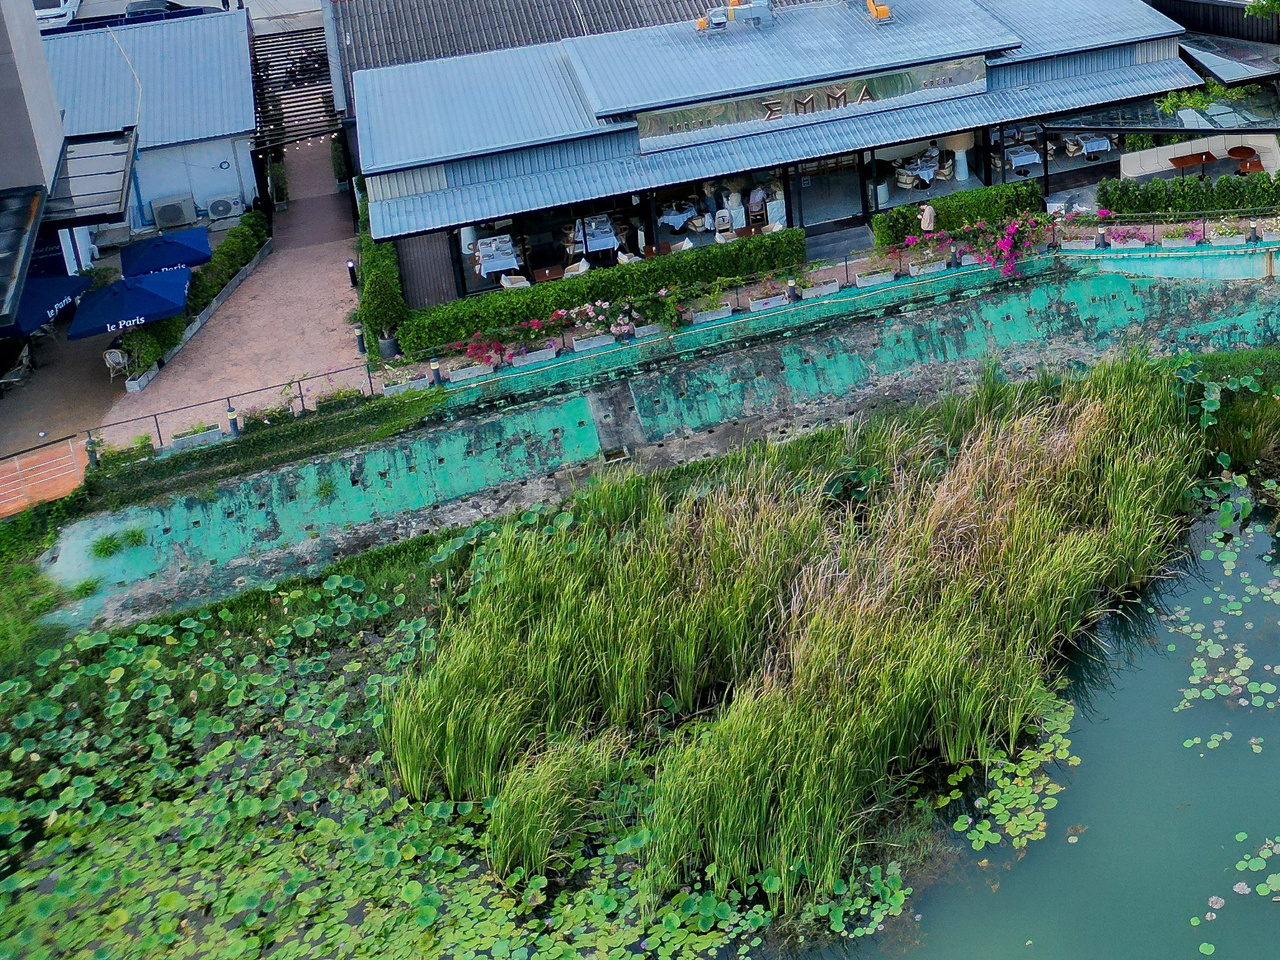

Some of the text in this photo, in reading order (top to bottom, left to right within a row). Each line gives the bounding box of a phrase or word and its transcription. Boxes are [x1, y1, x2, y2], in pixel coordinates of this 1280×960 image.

[46, 295, 72, 318] le Paris
[106, 315, 145, 332] le Paris
